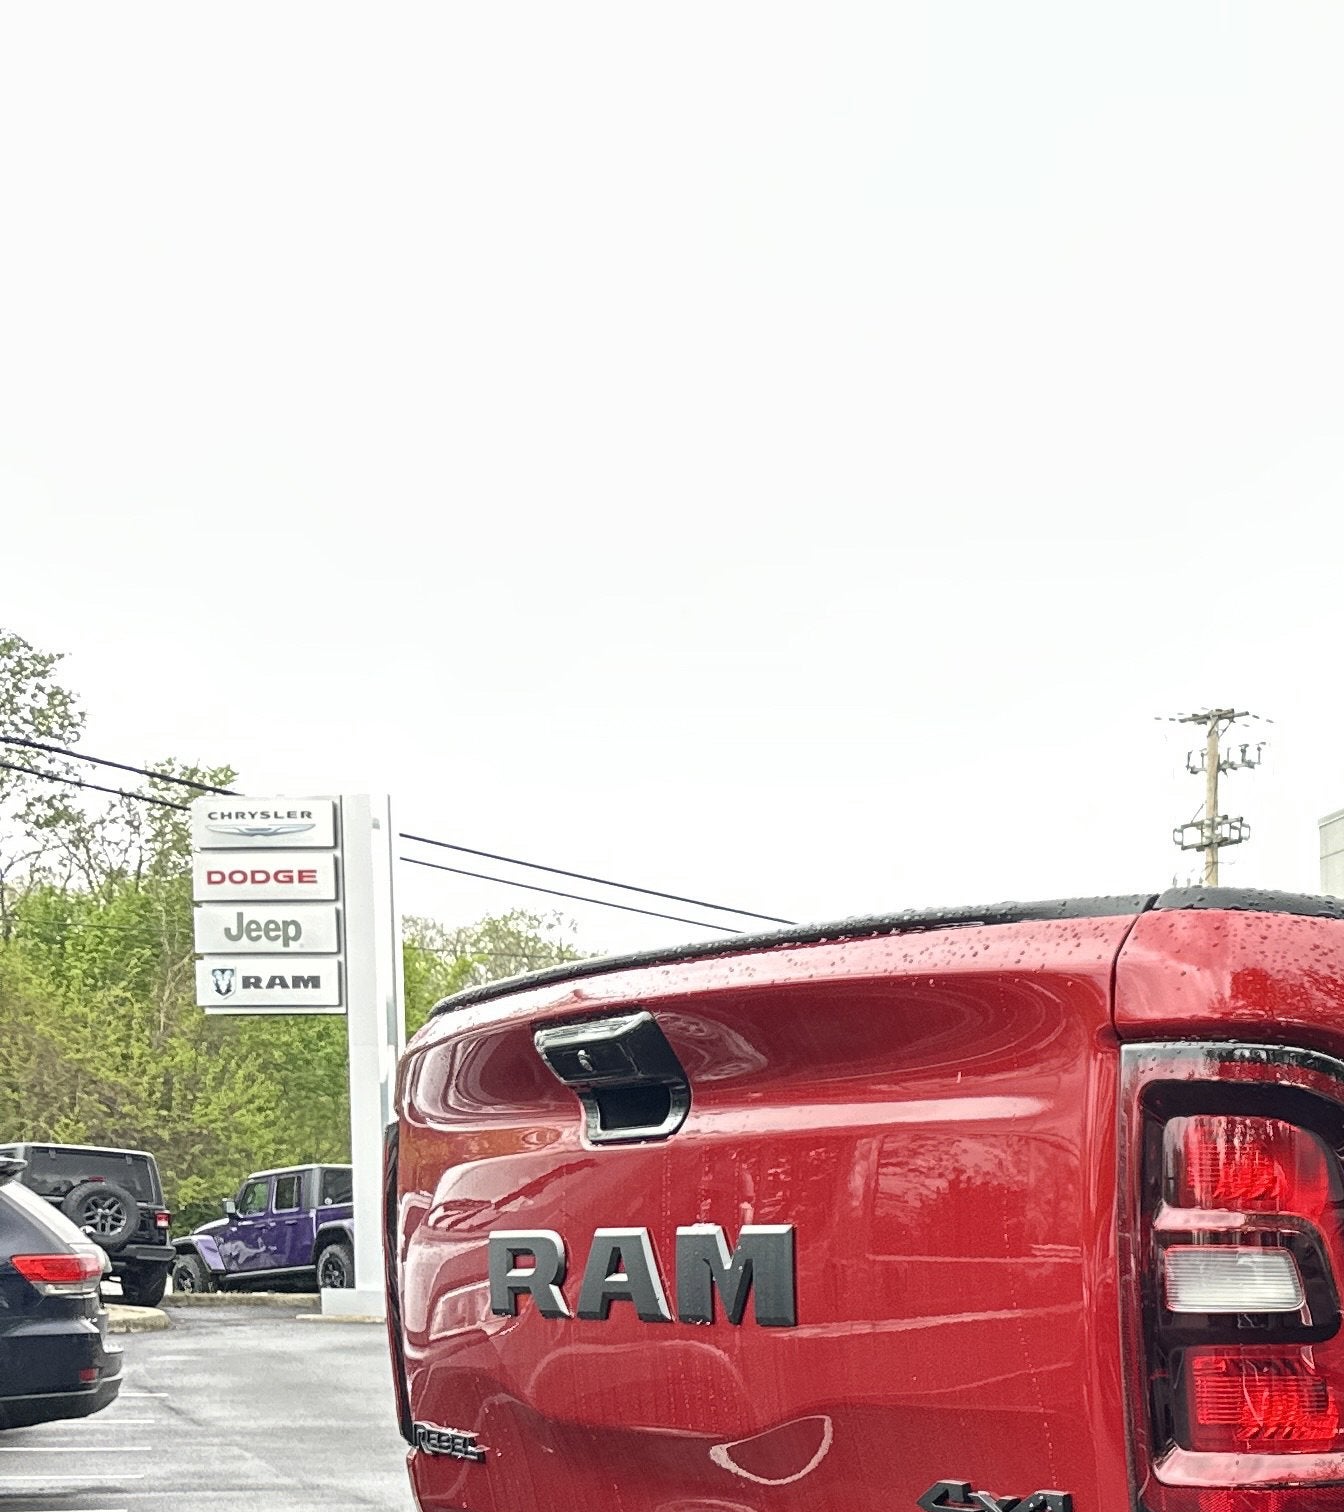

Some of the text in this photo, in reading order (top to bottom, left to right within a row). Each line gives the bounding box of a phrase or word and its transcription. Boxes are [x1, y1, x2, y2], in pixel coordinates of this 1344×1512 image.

[207, 810, 313, 821] CHRYSLER
[206, 869, 318, 886] DODGE
[223, 911, 303, 948] Jeep
[241, 975, 321, 990] RAM
[488, 1223, 798, 1327] RAM
[412, 1421, 487, 1463] REBEL
